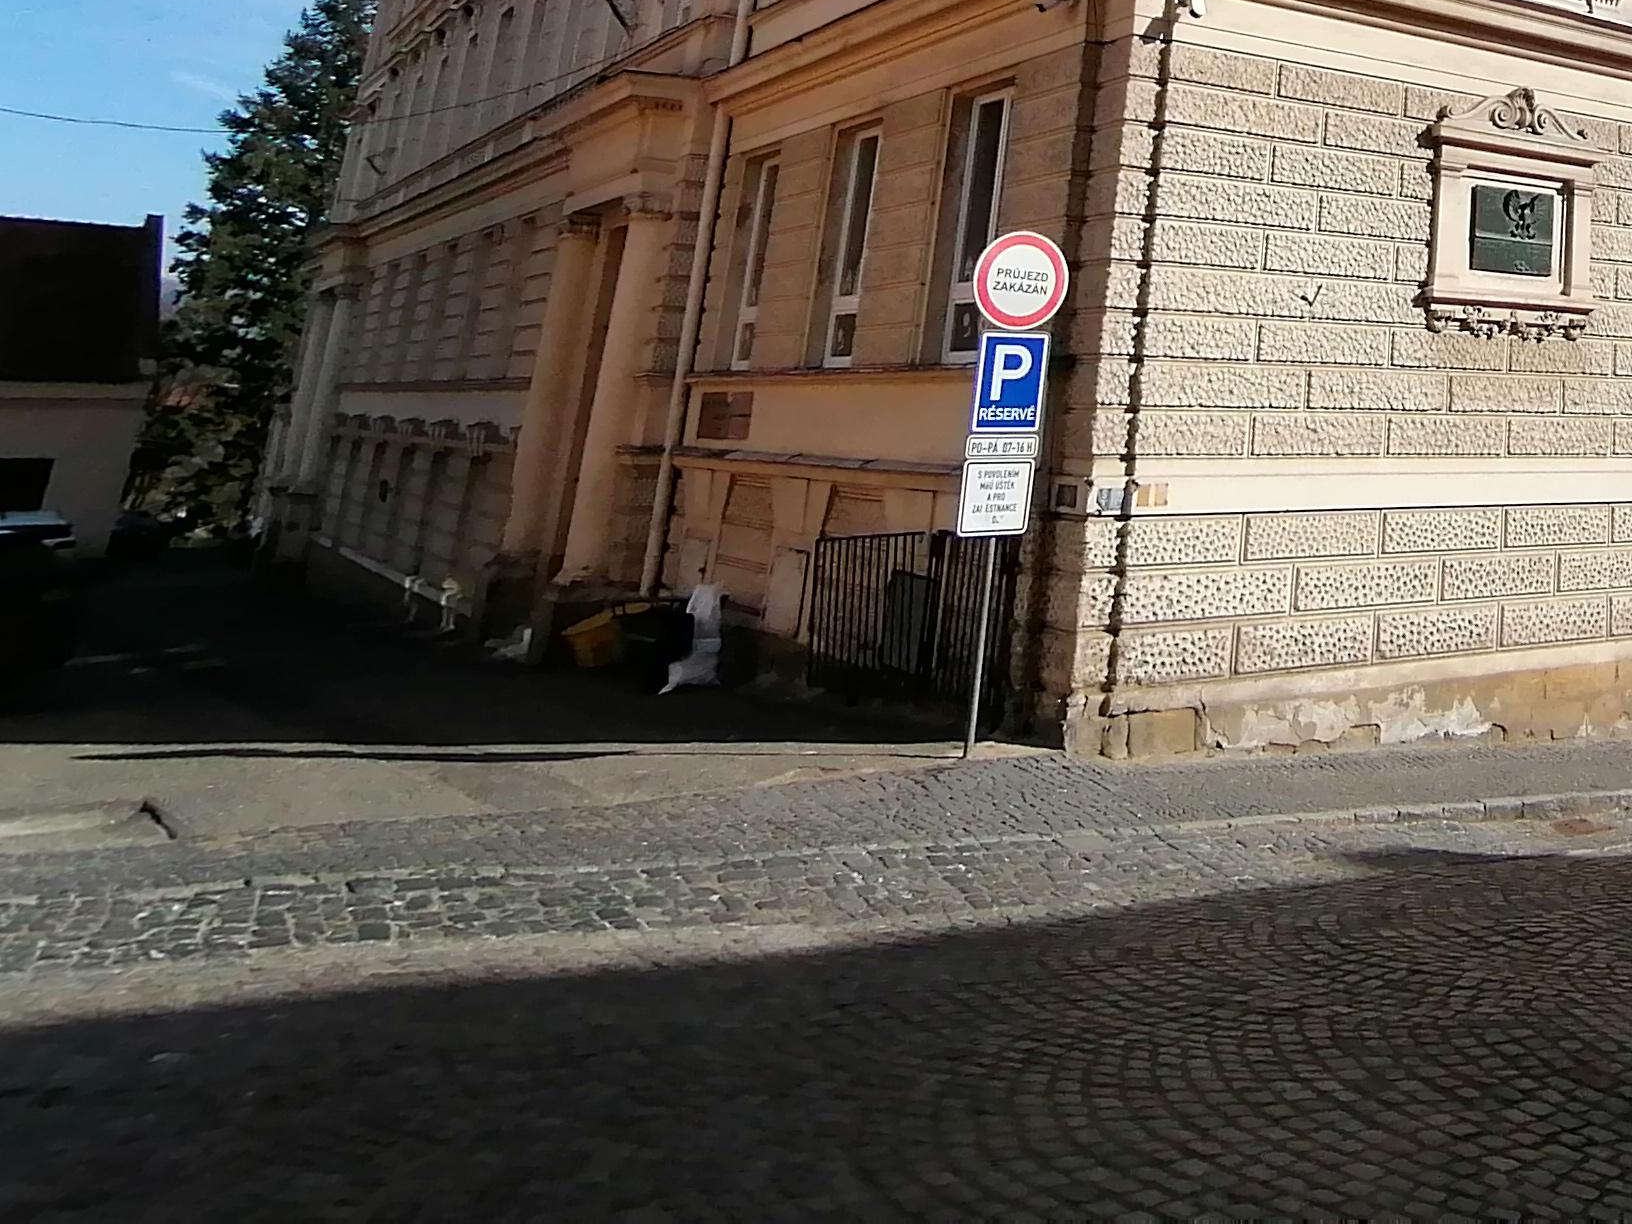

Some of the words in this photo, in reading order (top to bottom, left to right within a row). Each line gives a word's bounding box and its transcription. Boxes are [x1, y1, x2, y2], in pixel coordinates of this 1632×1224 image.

[997, 267, 1049, 282] PRŮJEZD
[992, 280, 1048, 295] ZAKÁZÁN
[990, 344, 1033, 401] P
[979, 404, 1036, 421] RÉSERVÉ
[971, 438, 998, 454] PO-PÁ
[1002, 441, 1025, 453] 07-16
[1026, 442, 1033, 453] H
